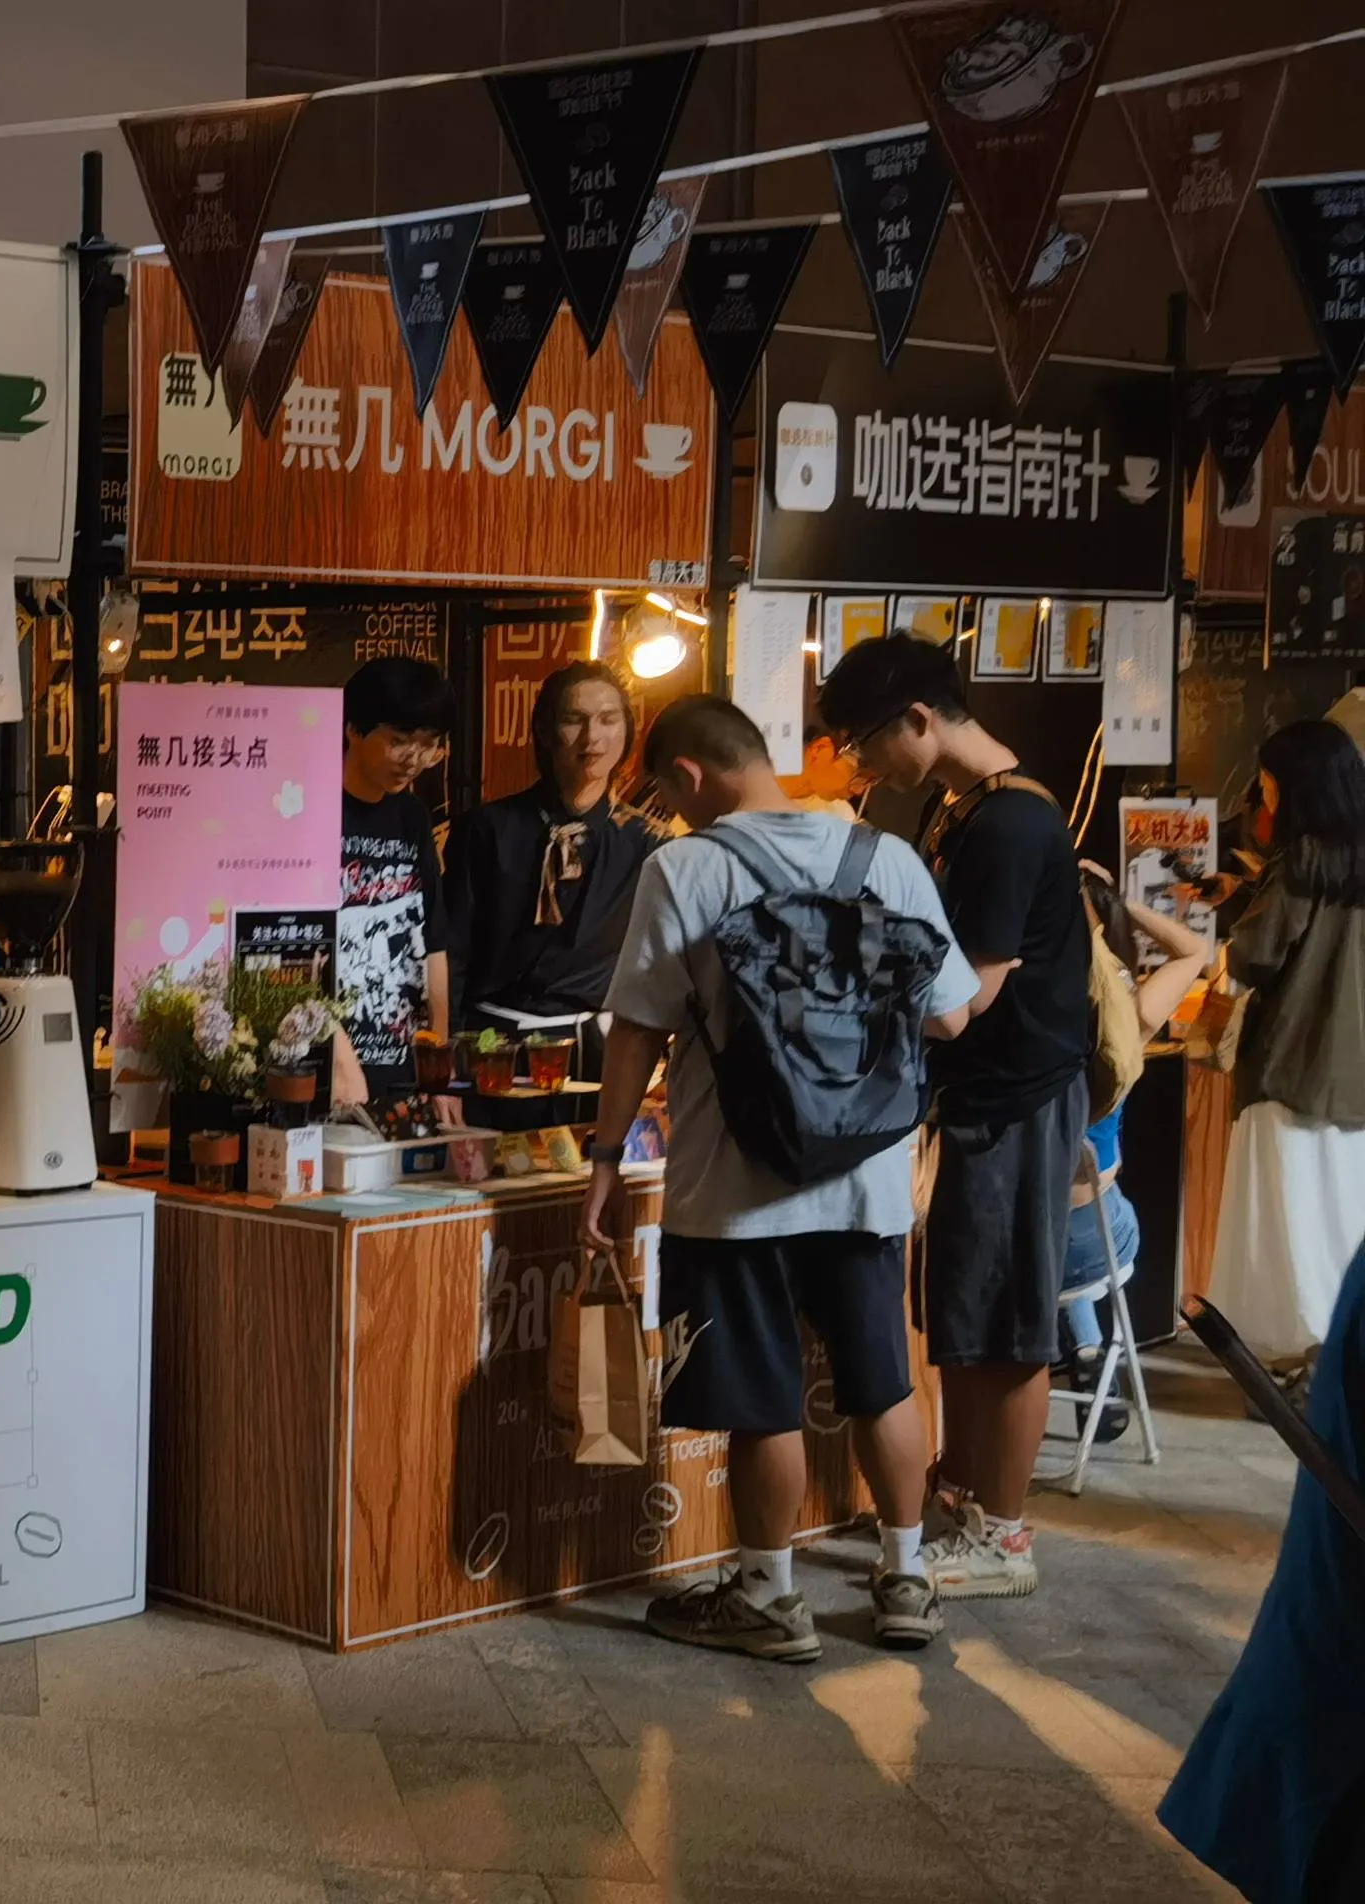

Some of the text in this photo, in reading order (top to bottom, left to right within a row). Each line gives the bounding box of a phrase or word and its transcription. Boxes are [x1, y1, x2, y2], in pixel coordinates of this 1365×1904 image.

[569, 160, 617, 196] Back
[580, 196, 604, 221] To
[567, 219, 618, 250] Black
[877, 215, 912, 245] Back
[884, 243, 900, 268] To
[875, 263, 913, 292] Black
[281, 376, 614, 481] 無几 MORGI
[163, 454, 232, 476] MORGI
[853, 409, 1110, 520] 咖选指南针
[365, 615, 438, 637] COFFEE
[354, 638, 438, 661] FESTIVAL
[137, 733, 269, 769] 無几接头点
